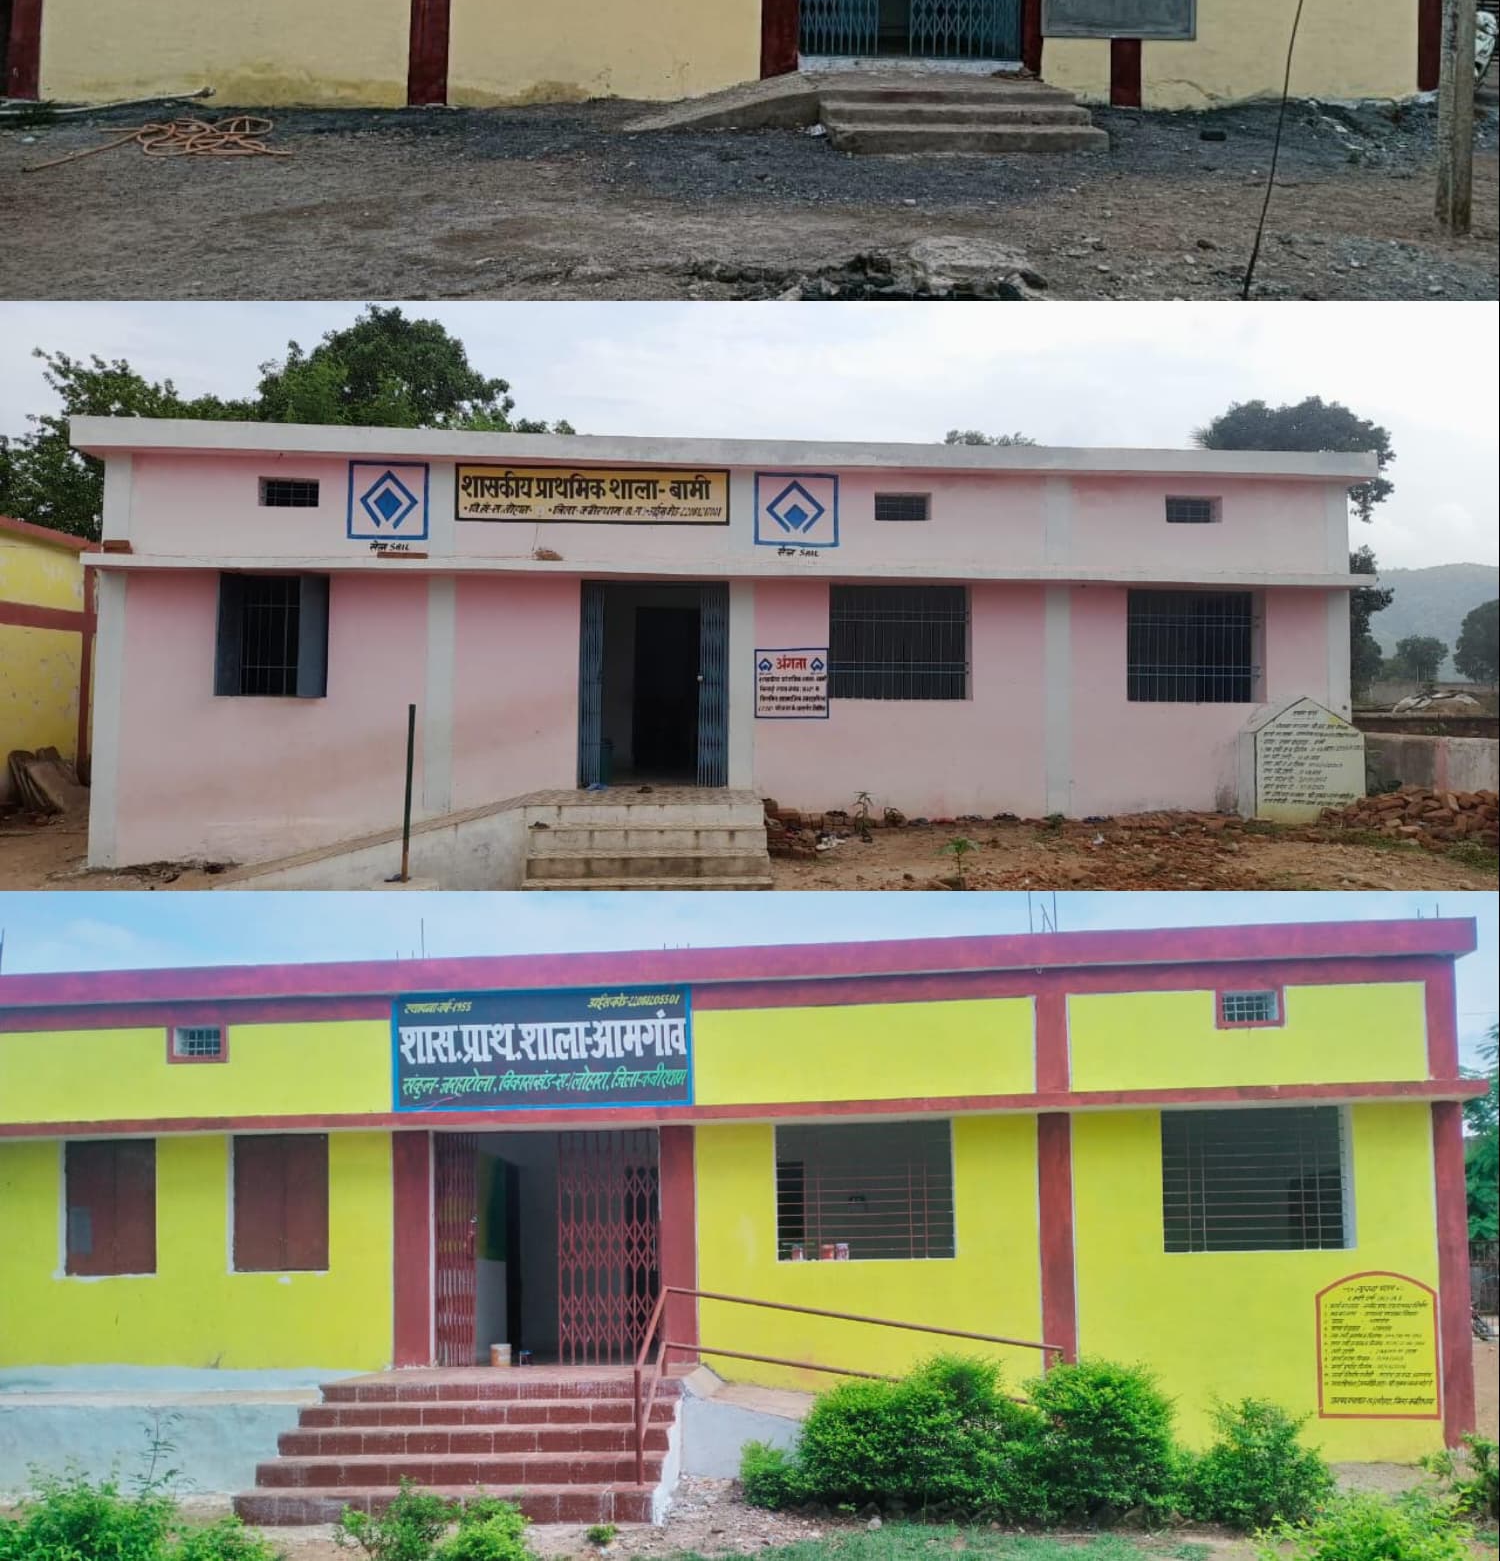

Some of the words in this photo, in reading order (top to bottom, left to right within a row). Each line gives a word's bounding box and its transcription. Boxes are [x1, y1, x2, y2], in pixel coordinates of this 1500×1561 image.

[461, 471, 533, 500] शासकीय
[534, 472, 607, 501] प्राथमिक
[670, 474, 712, 501] बामी
